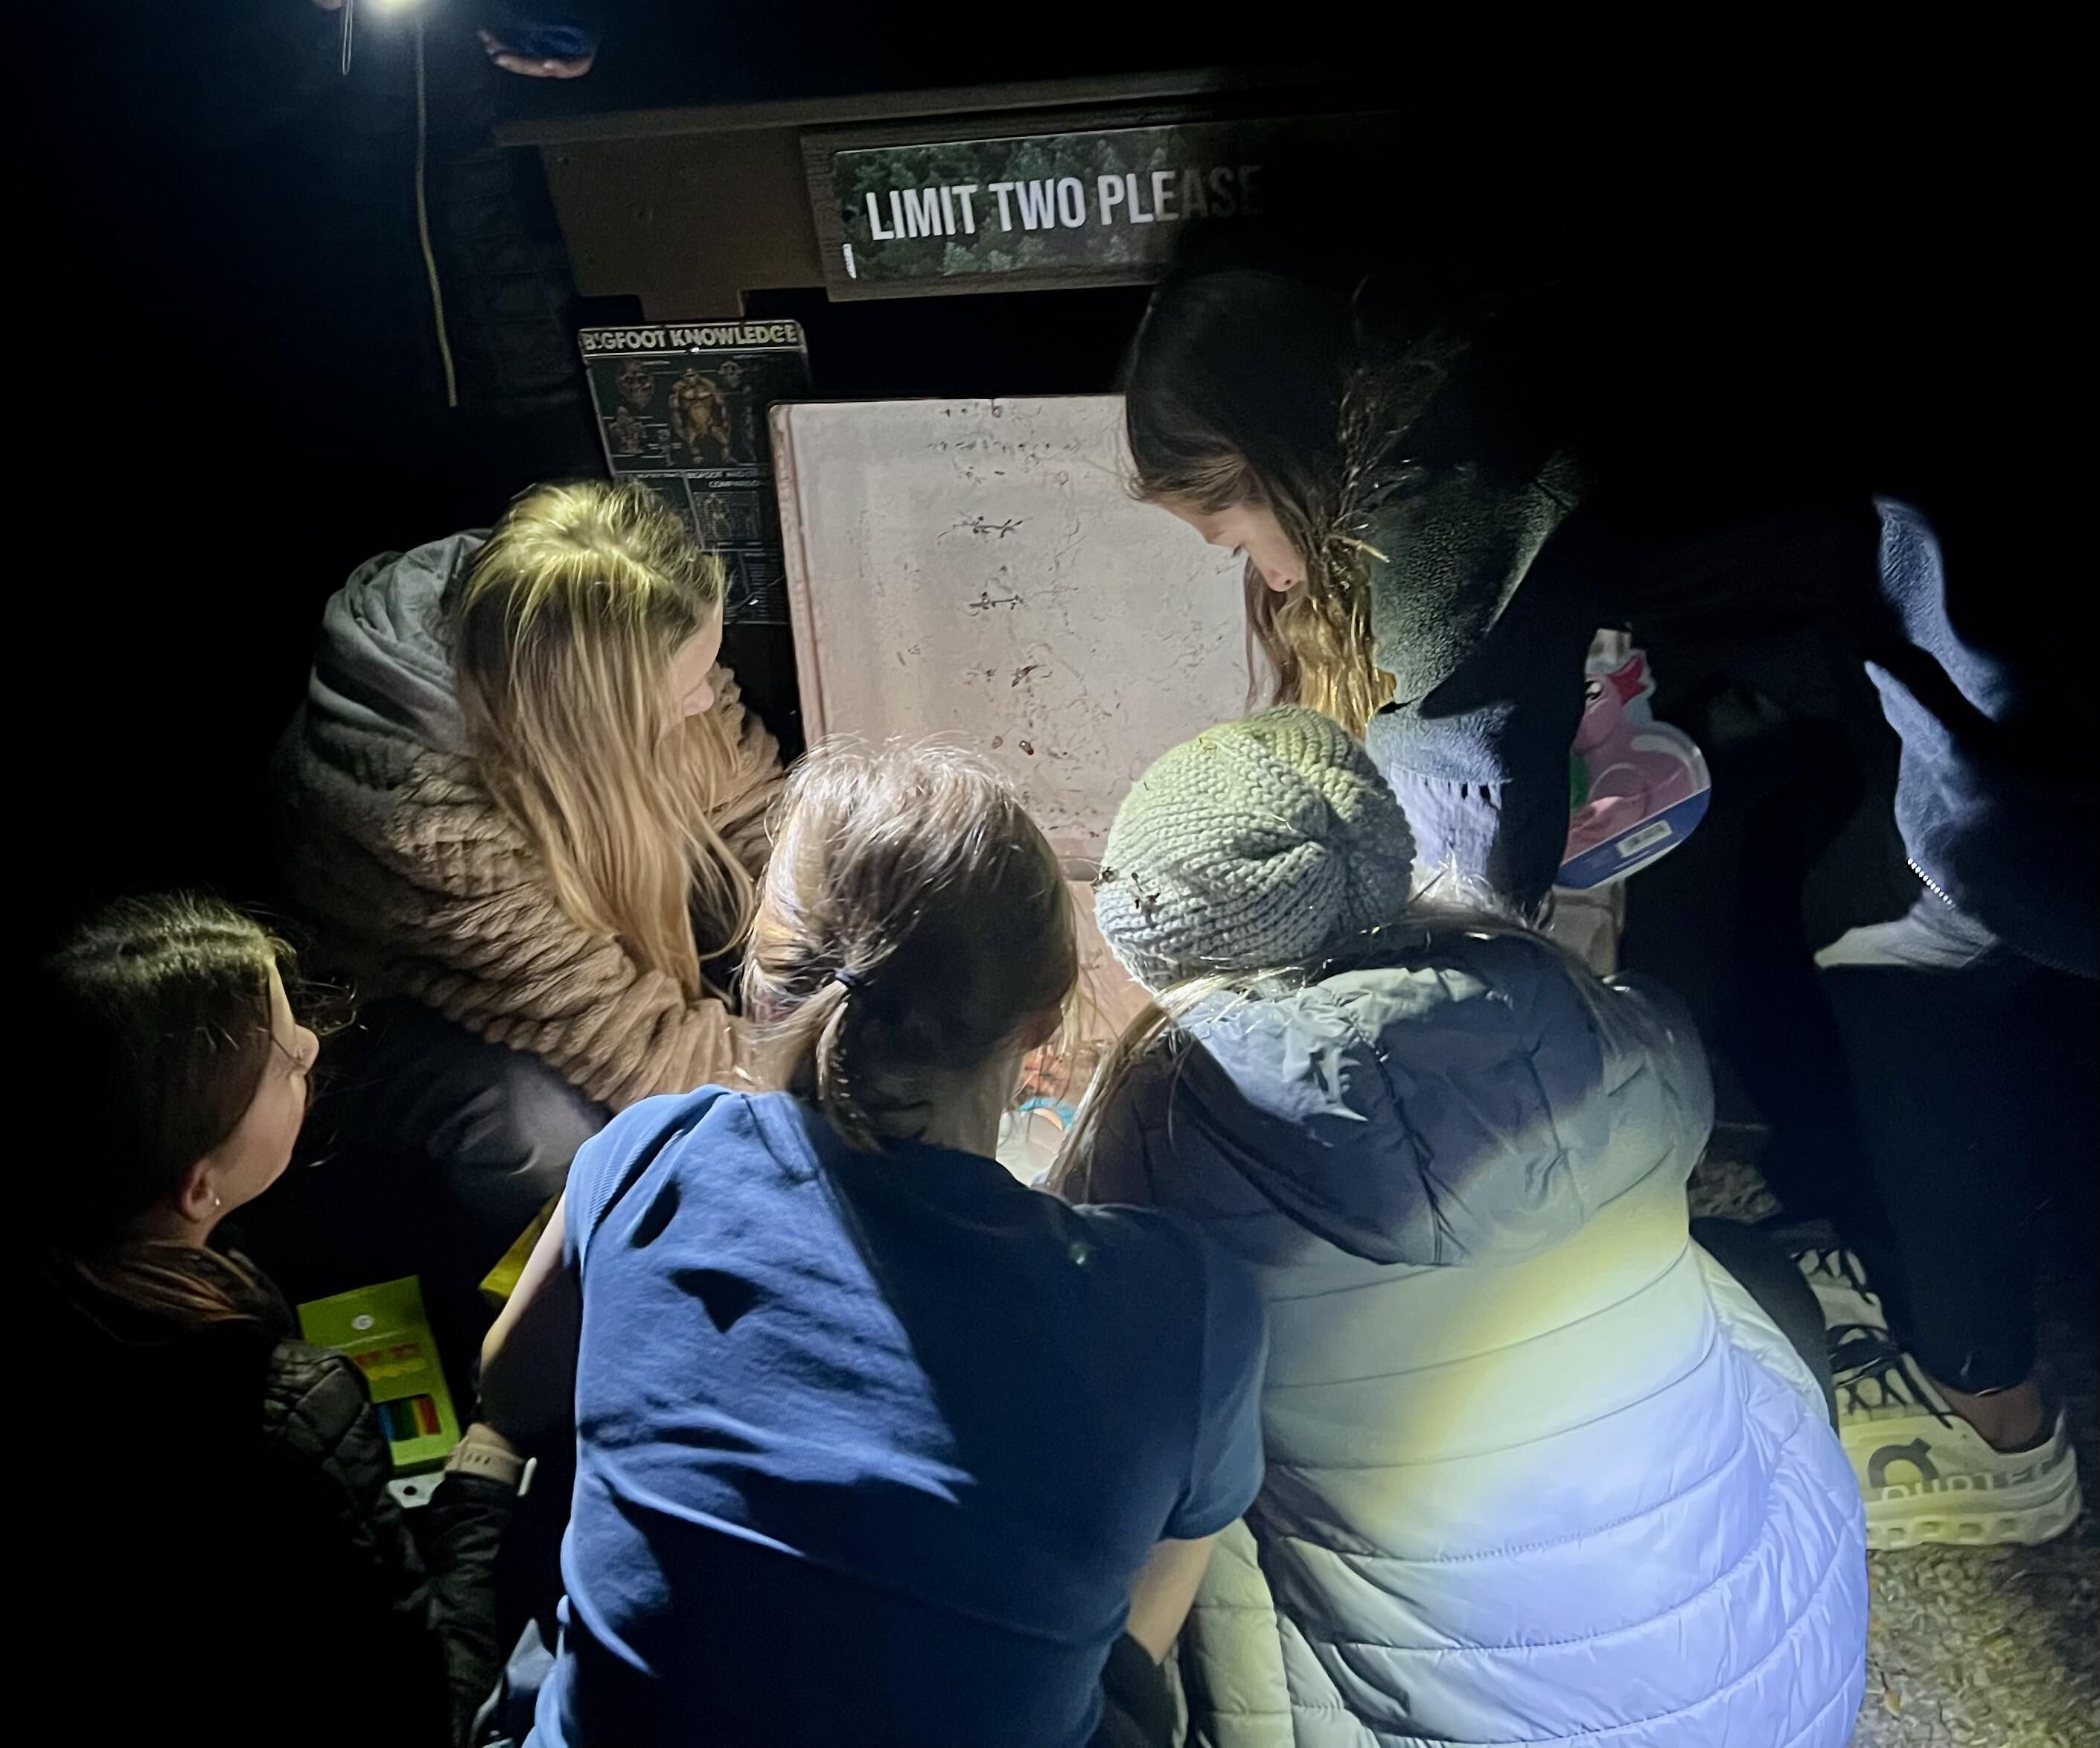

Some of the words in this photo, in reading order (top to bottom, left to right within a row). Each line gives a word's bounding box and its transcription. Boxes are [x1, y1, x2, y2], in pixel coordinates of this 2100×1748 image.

[866, 184, 977, 240] LIMIT
[988, 177, 1086, 232] TWO
[1097, 165, 1263, 226] PLEASE
[583, 330, 666, 351] BIGFOOT
[670, 324, 798, 347] KNOWLEDGE
